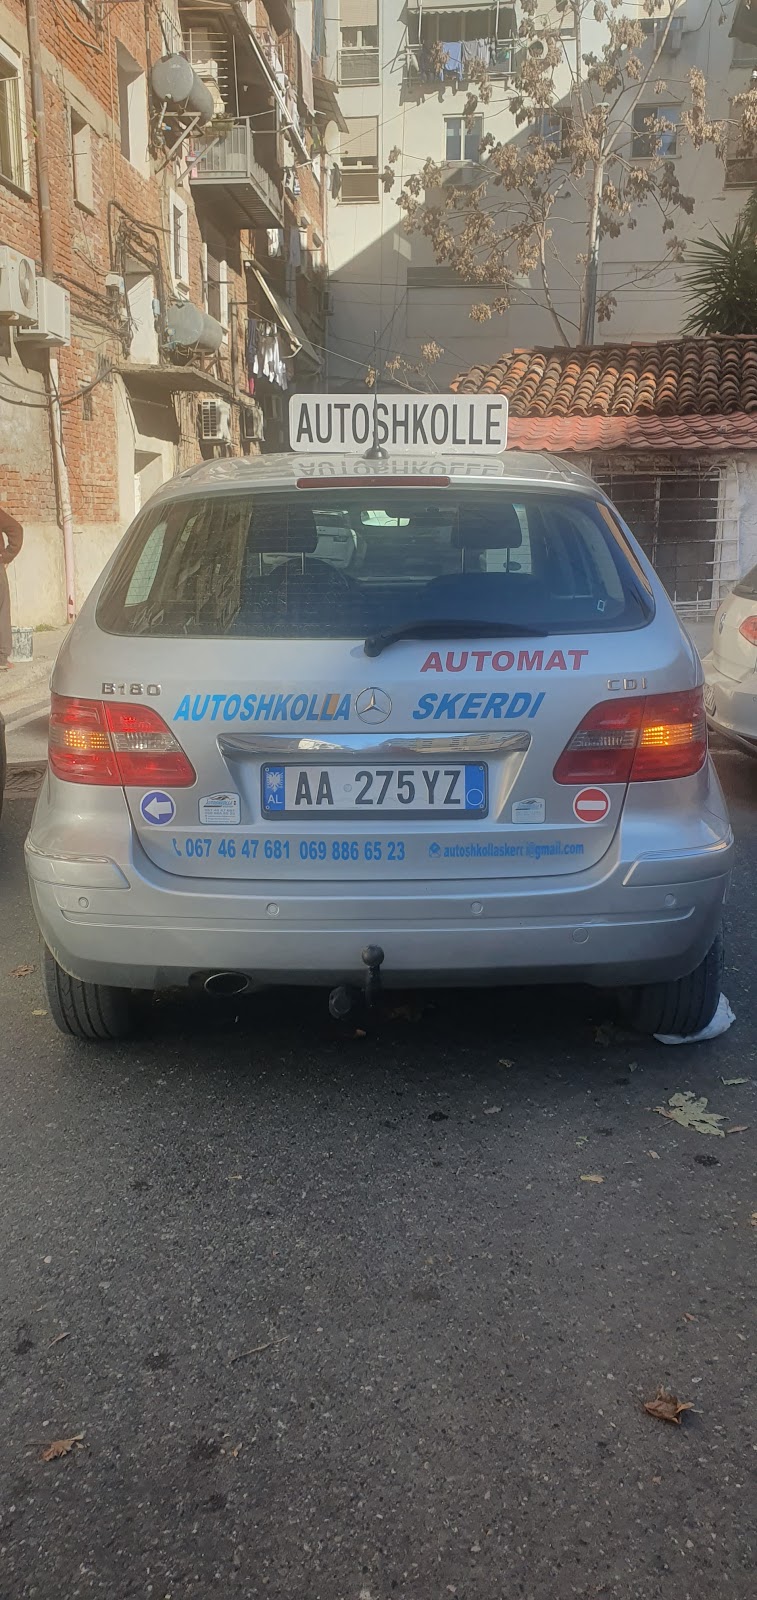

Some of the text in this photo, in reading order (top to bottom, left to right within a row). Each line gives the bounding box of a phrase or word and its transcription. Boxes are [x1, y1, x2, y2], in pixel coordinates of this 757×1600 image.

[296, 402, 503, 445] AUTOSHKOLLE
[420, 649, 589, 673] AUTOMAT
[101, 682, 162, 697] B180
[606, 676, 648, 691] CDI
[173, 692, 546, 721] AUTOSHKOLLA SKERDI
[294, 771, 334, 805] AA
[267, 794, 283, 804] AL
[185, 838, 290, 859] 067 46 47 681
[300, 840, 405, 861] 069 886 65 23
